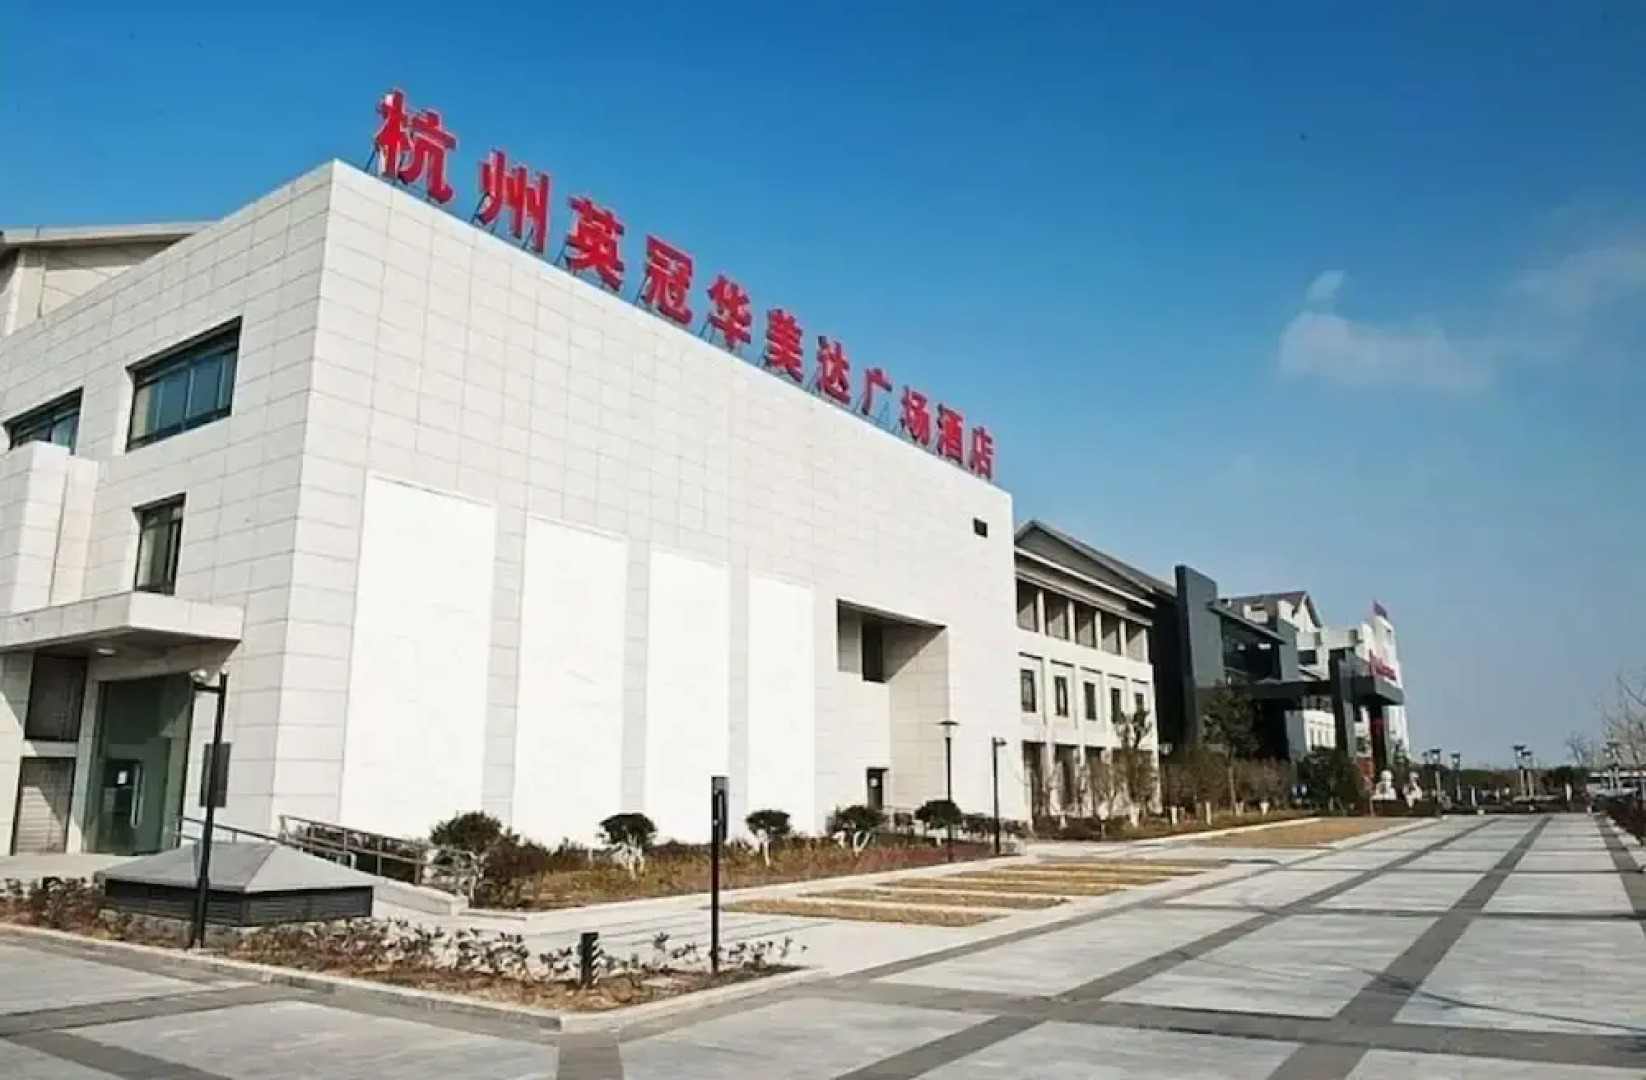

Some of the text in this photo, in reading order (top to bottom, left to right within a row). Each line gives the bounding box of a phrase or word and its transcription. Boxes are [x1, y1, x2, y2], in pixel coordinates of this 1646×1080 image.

[375, 88, 994, 480] 杭州英冠华美达广场酒店
